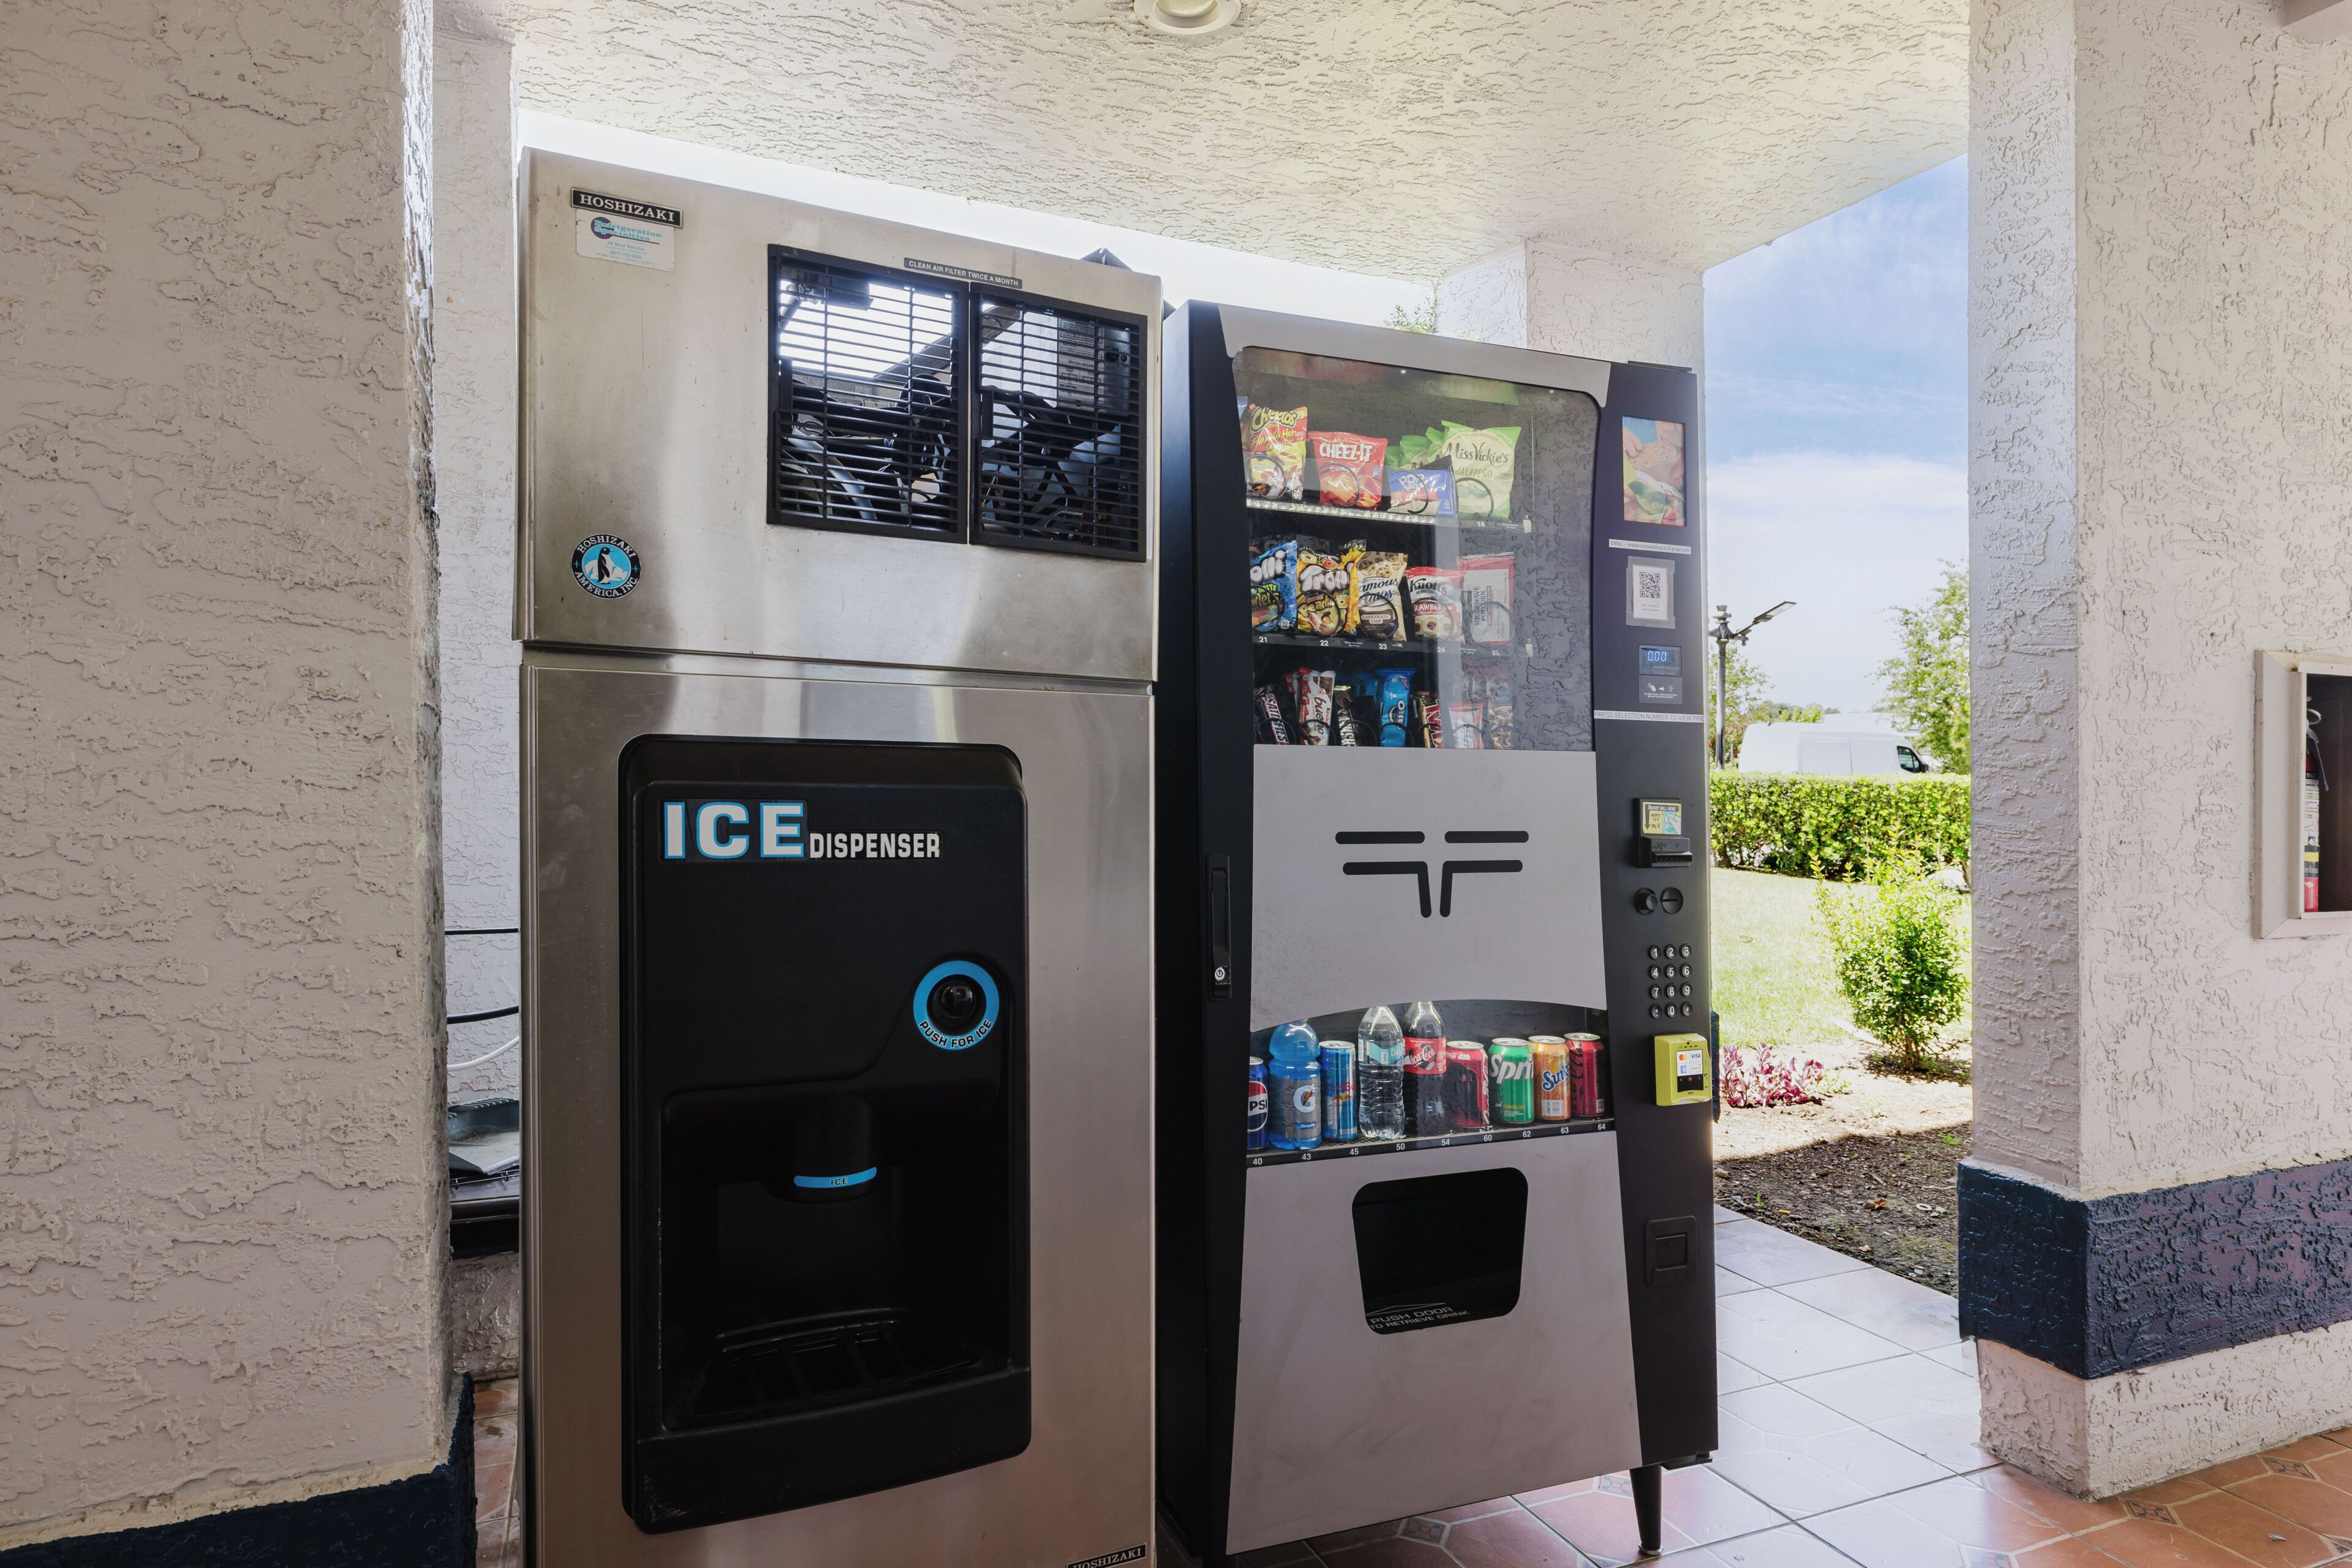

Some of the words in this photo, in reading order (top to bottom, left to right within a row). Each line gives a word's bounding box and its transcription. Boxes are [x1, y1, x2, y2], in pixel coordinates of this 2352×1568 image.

[579, 194, 675, 222] HOSHIZAKI
[594, 225, 650, 241] Specialties
[595, 219, 662, 238] Refrigeration
[909, 260, 931, 270] CLEAN
[945, 268, 967, 277] FILTER
[968, 271, 988, 281] TWICE
[995, 277, 1019, 286] MONTH
[1251, 406, 1298, 432] Cheetos
[1282, 429, 1297, 437] Hot
[1319, 442, 1373, 462] CHEEZ-IT
[1443, 442, 1473, 460] Miss
[1472, 442, 1509, 468] Vickie's
[1455, 466, 1492, 478] JALAPEÑO
[577, 535, 636, 558] HOSHIZAKI
[1250, 550, 1285, 581] olli
[575, 571, 622, 597] AMERICA,
[620, 577, 638, 594] INC.
[1360, 578, 1398, 592] amous
[1648, 651, 1667, 662] 0.00
[1266, 697, 1288, 742] SATIFIES
[1314, 696, 1327, 735] bueno
[664, 802, 804, 859] ICE
[810, 832, 940, 858] DISPENSER
[1654, 948, 1657, 957] 1
[1669, 948, 1673, 956] 2
[1684, 947, 1689, 956] 3
[1653, 968, 1659, 977] 4
[1669, 967, 1674, 976] 5
[1684, 966, 1689, 976] 6
[1654, 987, 1659, 997] 7
[1670, 987, 1674, 996] 8
[1685, 986, 1690, 995] 9
[1670, 1006, 1675, 1015] 0
[919, 1019, 949, 1047] PUSH
[951, 1035, 976, 1049] FOR
[975, 1019, 993, 1039] ICE
[1446, 1051, 1458, 1060] oca-Cola
[1490, 1054, 1534, 1084] Spri
[1542, 1063, 1570, 1091] Sunk
[1344, 1081, 1356, 1091] Bu
[1250, 1098, 1268, 1112] PSI
[1293, 1084, 1316, 1114] G
[830, 1177, 848, 1186] ICE
[1370, 1313, 1410, 1324] PUSH
[1413, 1307, 1454, 1317] DOOR
[1386, 1316, 1434, 1328] RETRIEVE
[1436, 1310, 1471, 1319] DRINK
[1072, 1548, 1142, 1568] HOSHIZAKI
